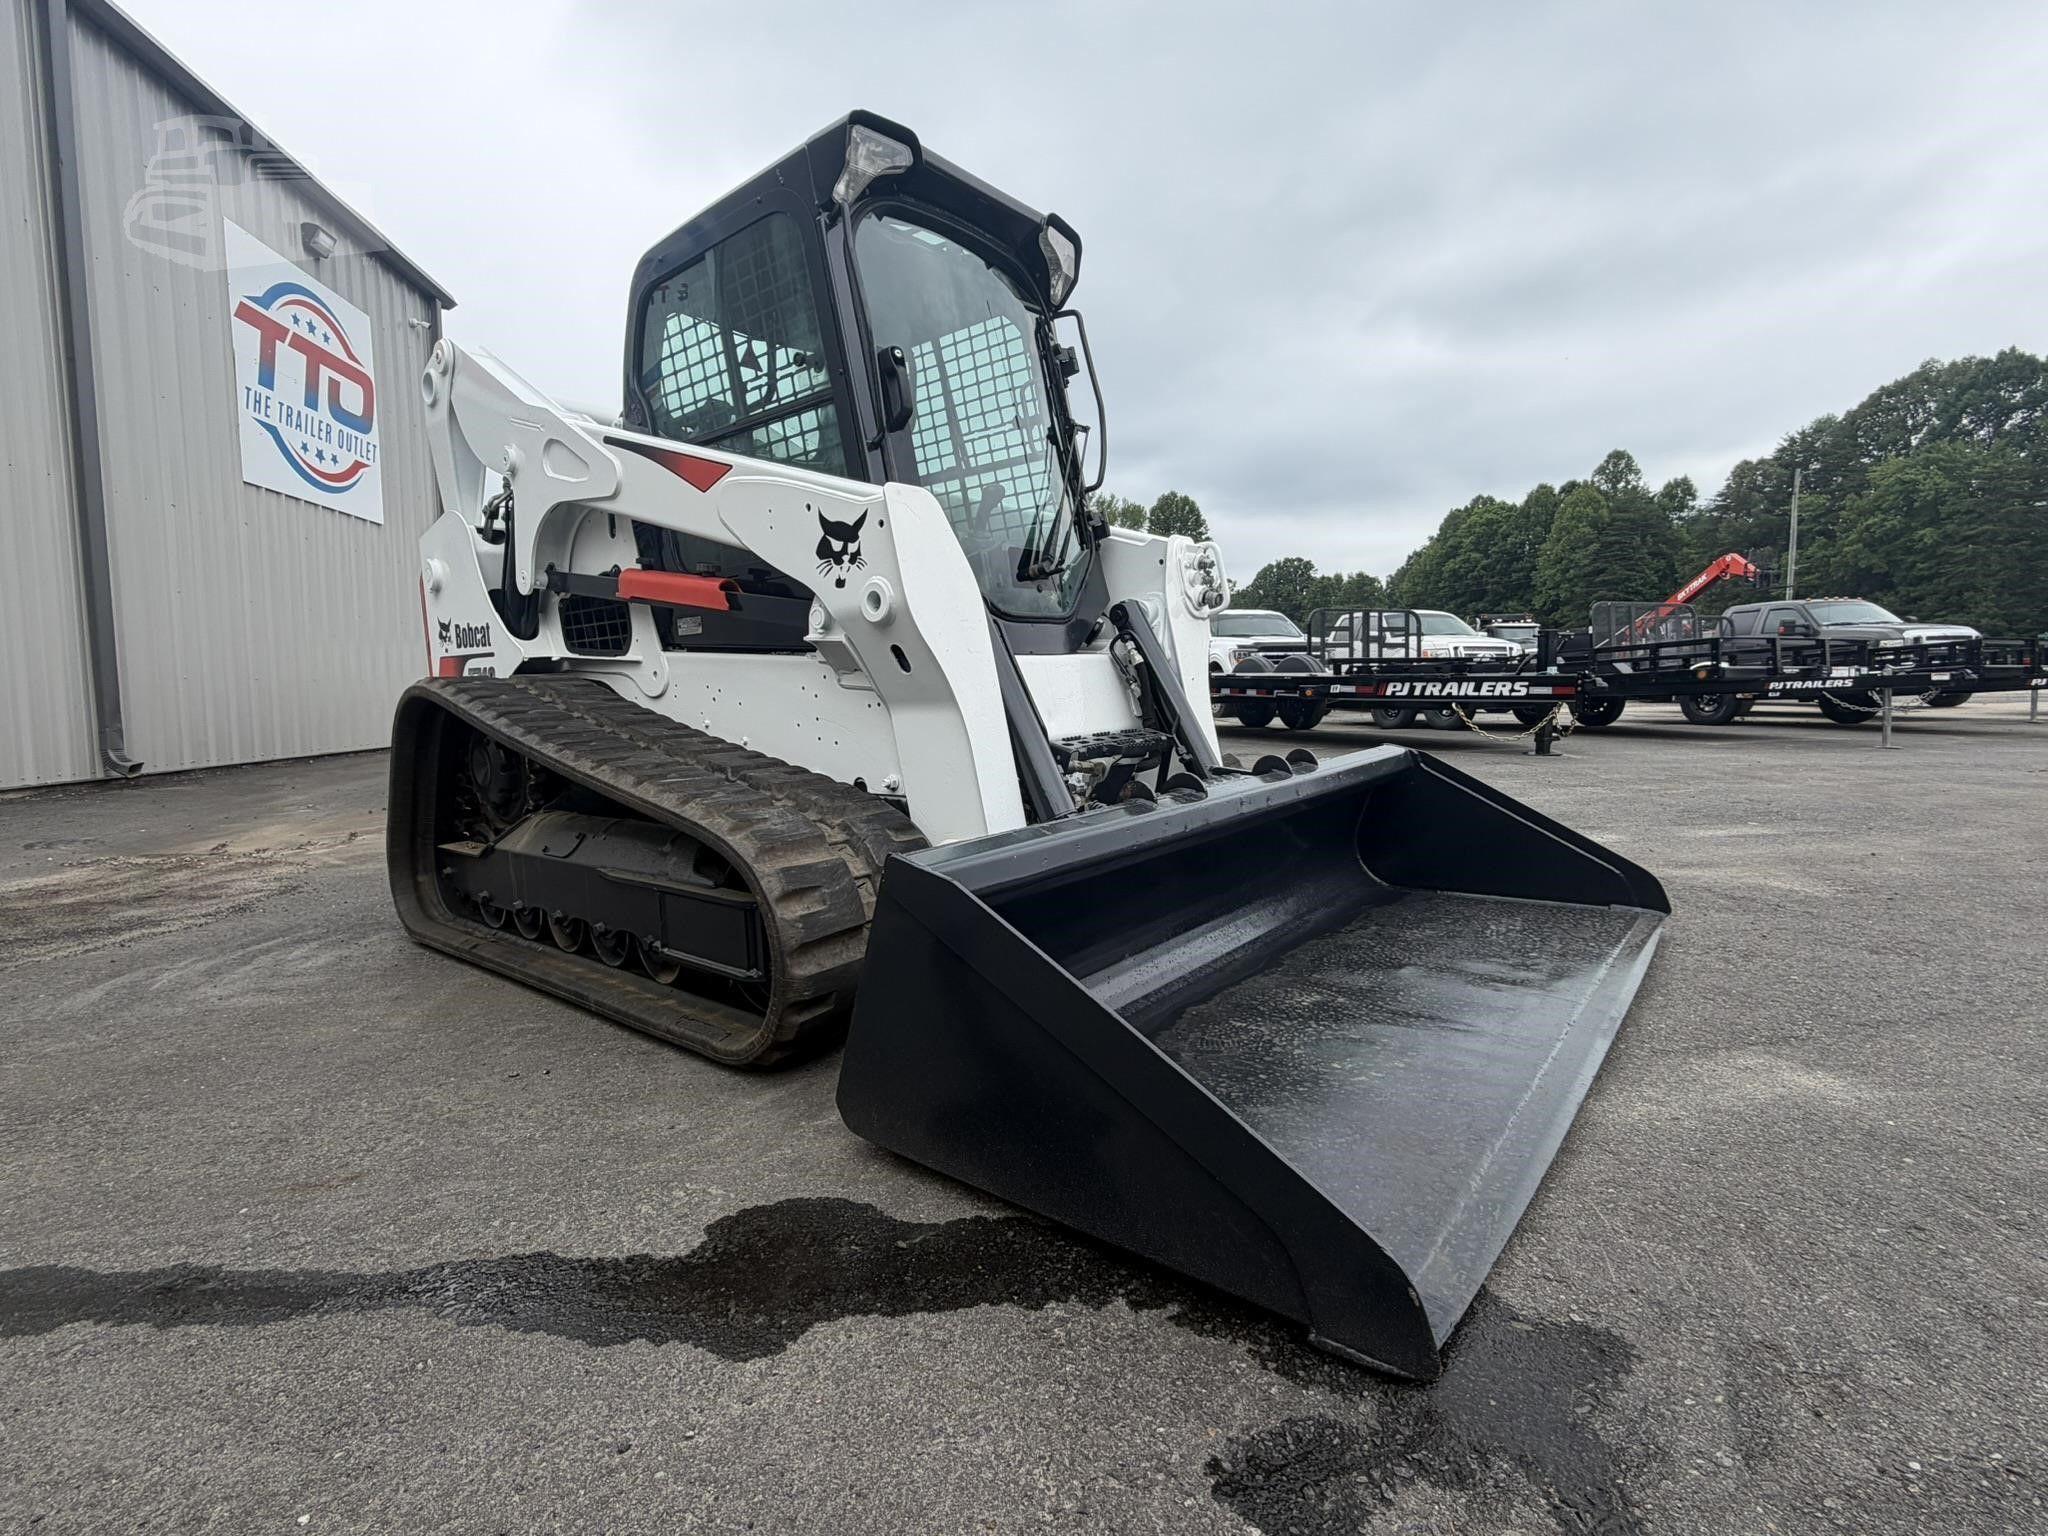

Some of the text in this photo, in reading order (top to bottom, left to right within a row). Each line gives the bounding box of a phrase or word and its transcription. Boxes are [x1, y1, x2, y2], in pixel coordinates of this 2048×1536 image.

[234, 301, 374, 435] TTO
[245, 386, 377, 463] THE TRAILER OUTLET
[454, 622, 491, 649] Bobcat
[1385, 682, 1529, 696] PJ TRAILERS
[1769, 679, 1854, 690] PJ TRAILERS
